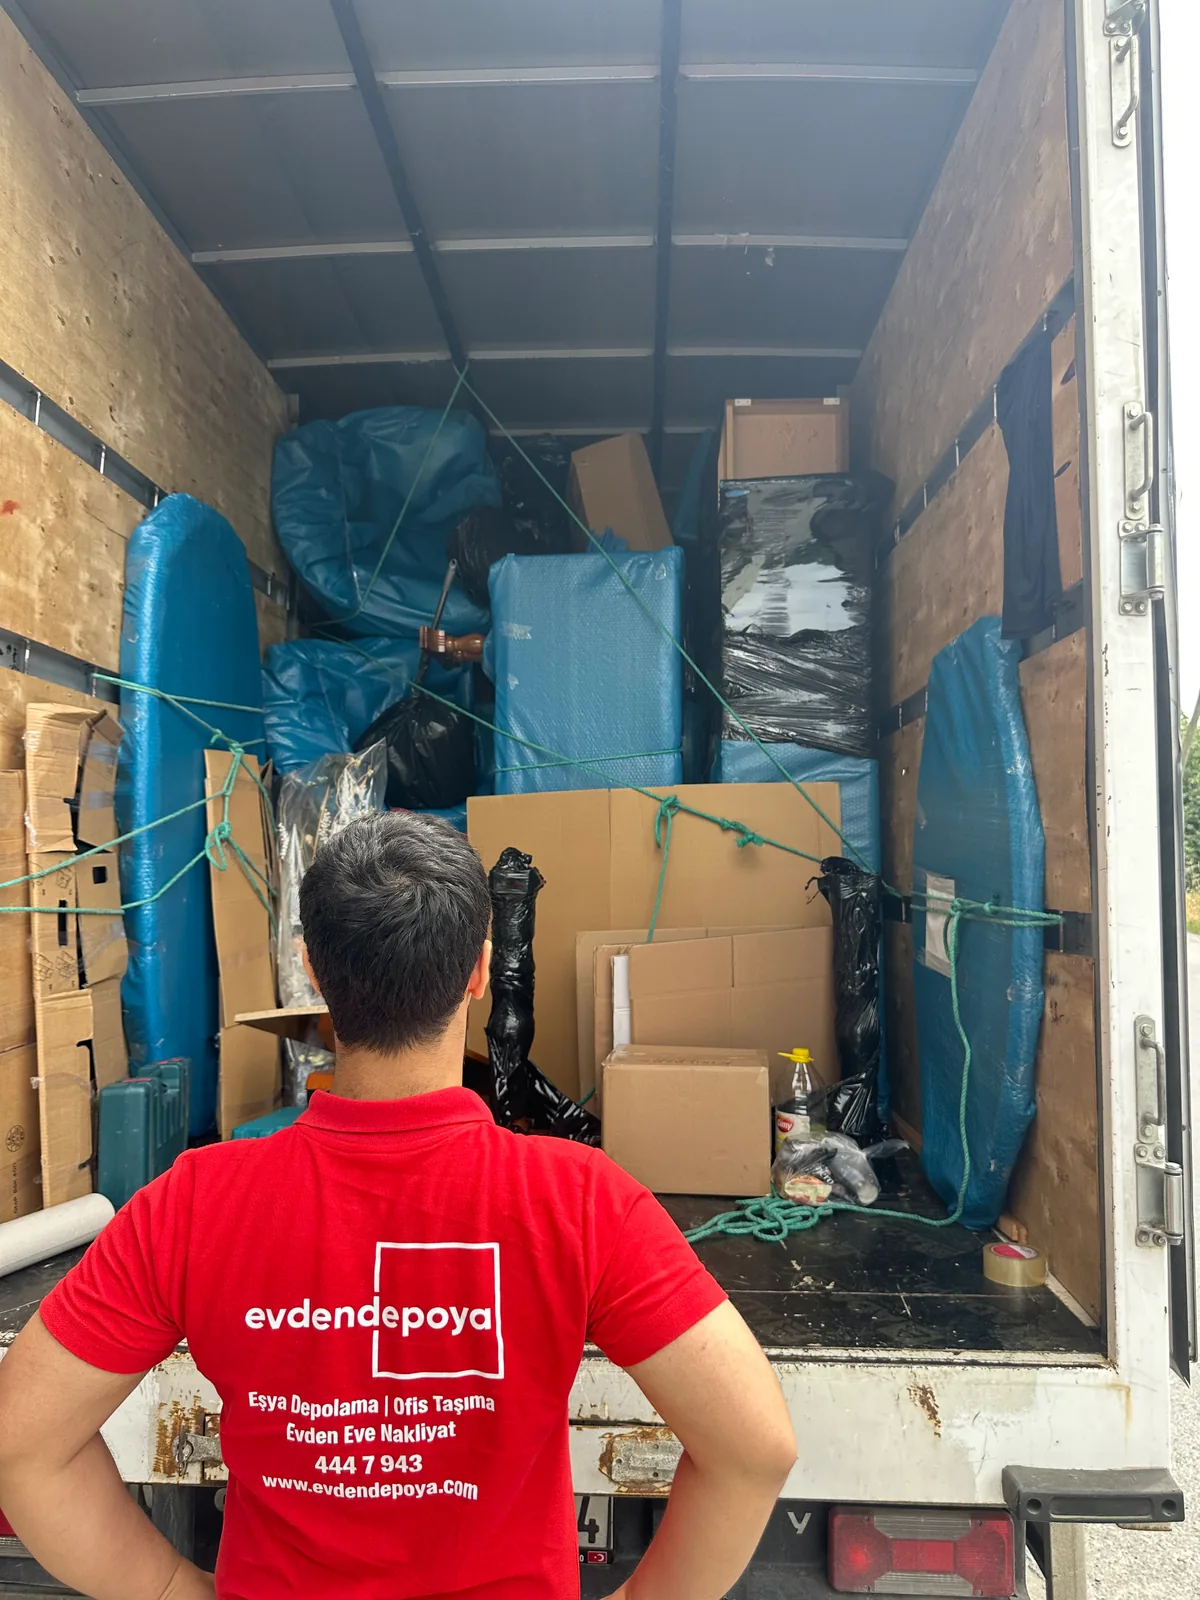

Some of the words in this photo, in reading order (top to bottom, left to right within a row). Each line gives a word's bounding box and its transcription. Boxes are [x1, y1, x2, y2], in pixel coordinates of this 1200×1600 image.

[244, 1298, 492, 1337] evdendepoya
[248, 1391, 287, 1411] Eşya
[291, 1394, 379, 1421] Depolama
[393, 1396, 429, 1416] Ofis
[432, 1395, 496, 1416] Taşıma
[286, 1422, 339, 1444] Evden
[343, 1425, 376, 1444] Eve
[380, 1421, 457, 1443] Nakliyat
[314, 1455, 357, 1475] 444
[361, 1455, 376, 1475] 7
[380, 1454, 423, 1473] 943
[261, 1475, 479, 1500] www.evdendepoya.com
